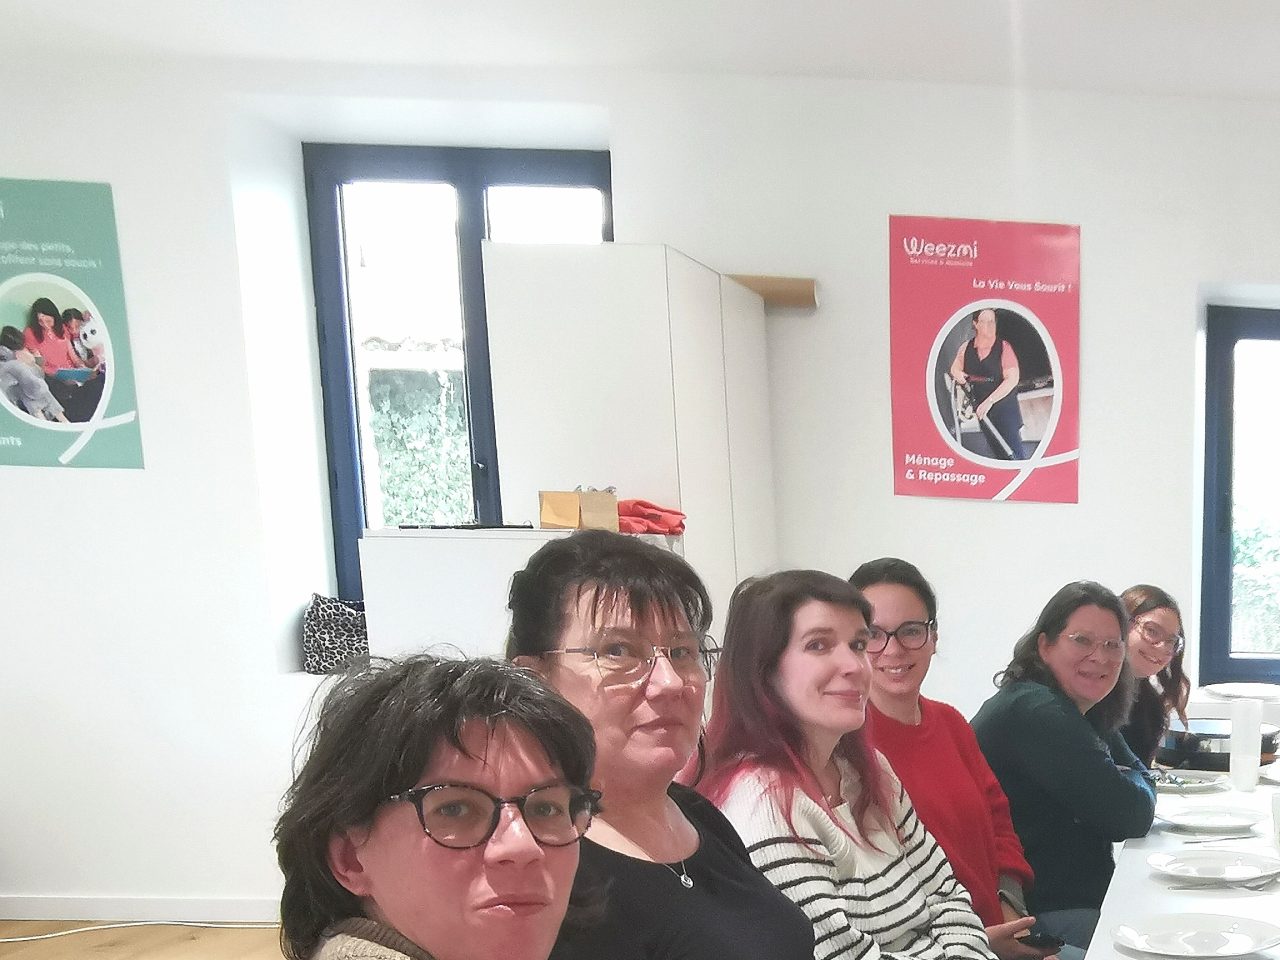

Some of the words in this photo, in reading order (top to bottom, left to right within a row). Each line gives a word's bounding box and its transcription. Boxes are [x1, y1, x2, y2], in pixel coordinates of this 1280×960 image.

[903, 236, 978, 259] Weezmi
[988, 279, 1005, 290] Vie
[1007, 280, 1032, 291] Vous
[905, 453, 955, 469] Ménage
[905, 469, 915, 480] &
[918, 469, 986, 486] Repassage
